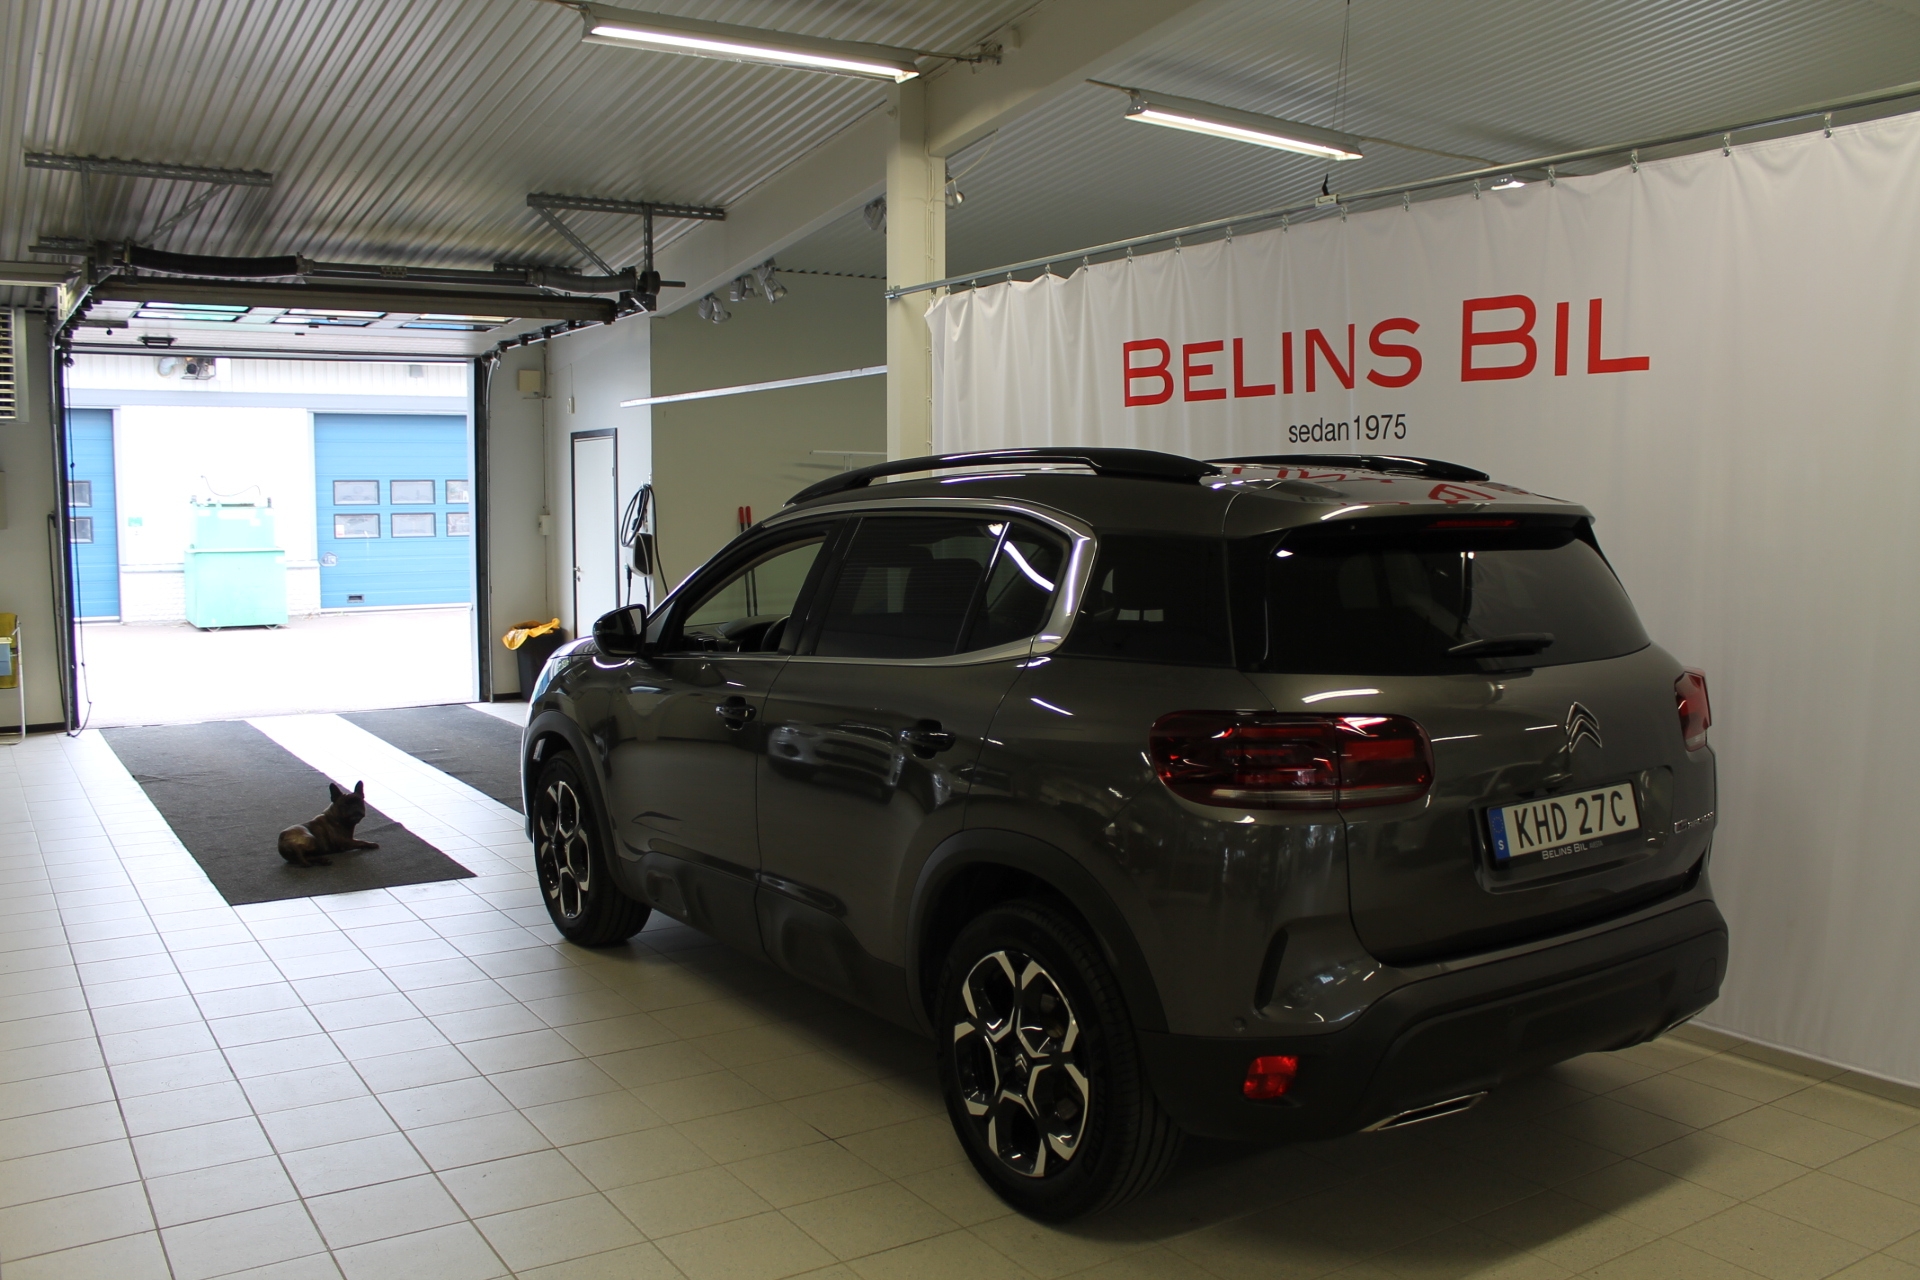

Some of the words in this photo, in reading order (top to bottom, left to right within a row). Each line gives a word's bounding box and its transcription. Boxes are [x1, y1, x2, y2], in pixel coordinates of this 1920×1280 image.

[1122, 317, 1423, 407] BELINS
[1460, 293, 1651, 383] BIL
[1513, 802, 1568, 849] KHD
[1575, 790, 1626, 836] 27C
[1497, 839, 1506, 851] S
[1541, 845, 1573, 860] BELINS
[1573, 842, 1588, 854] BIL
